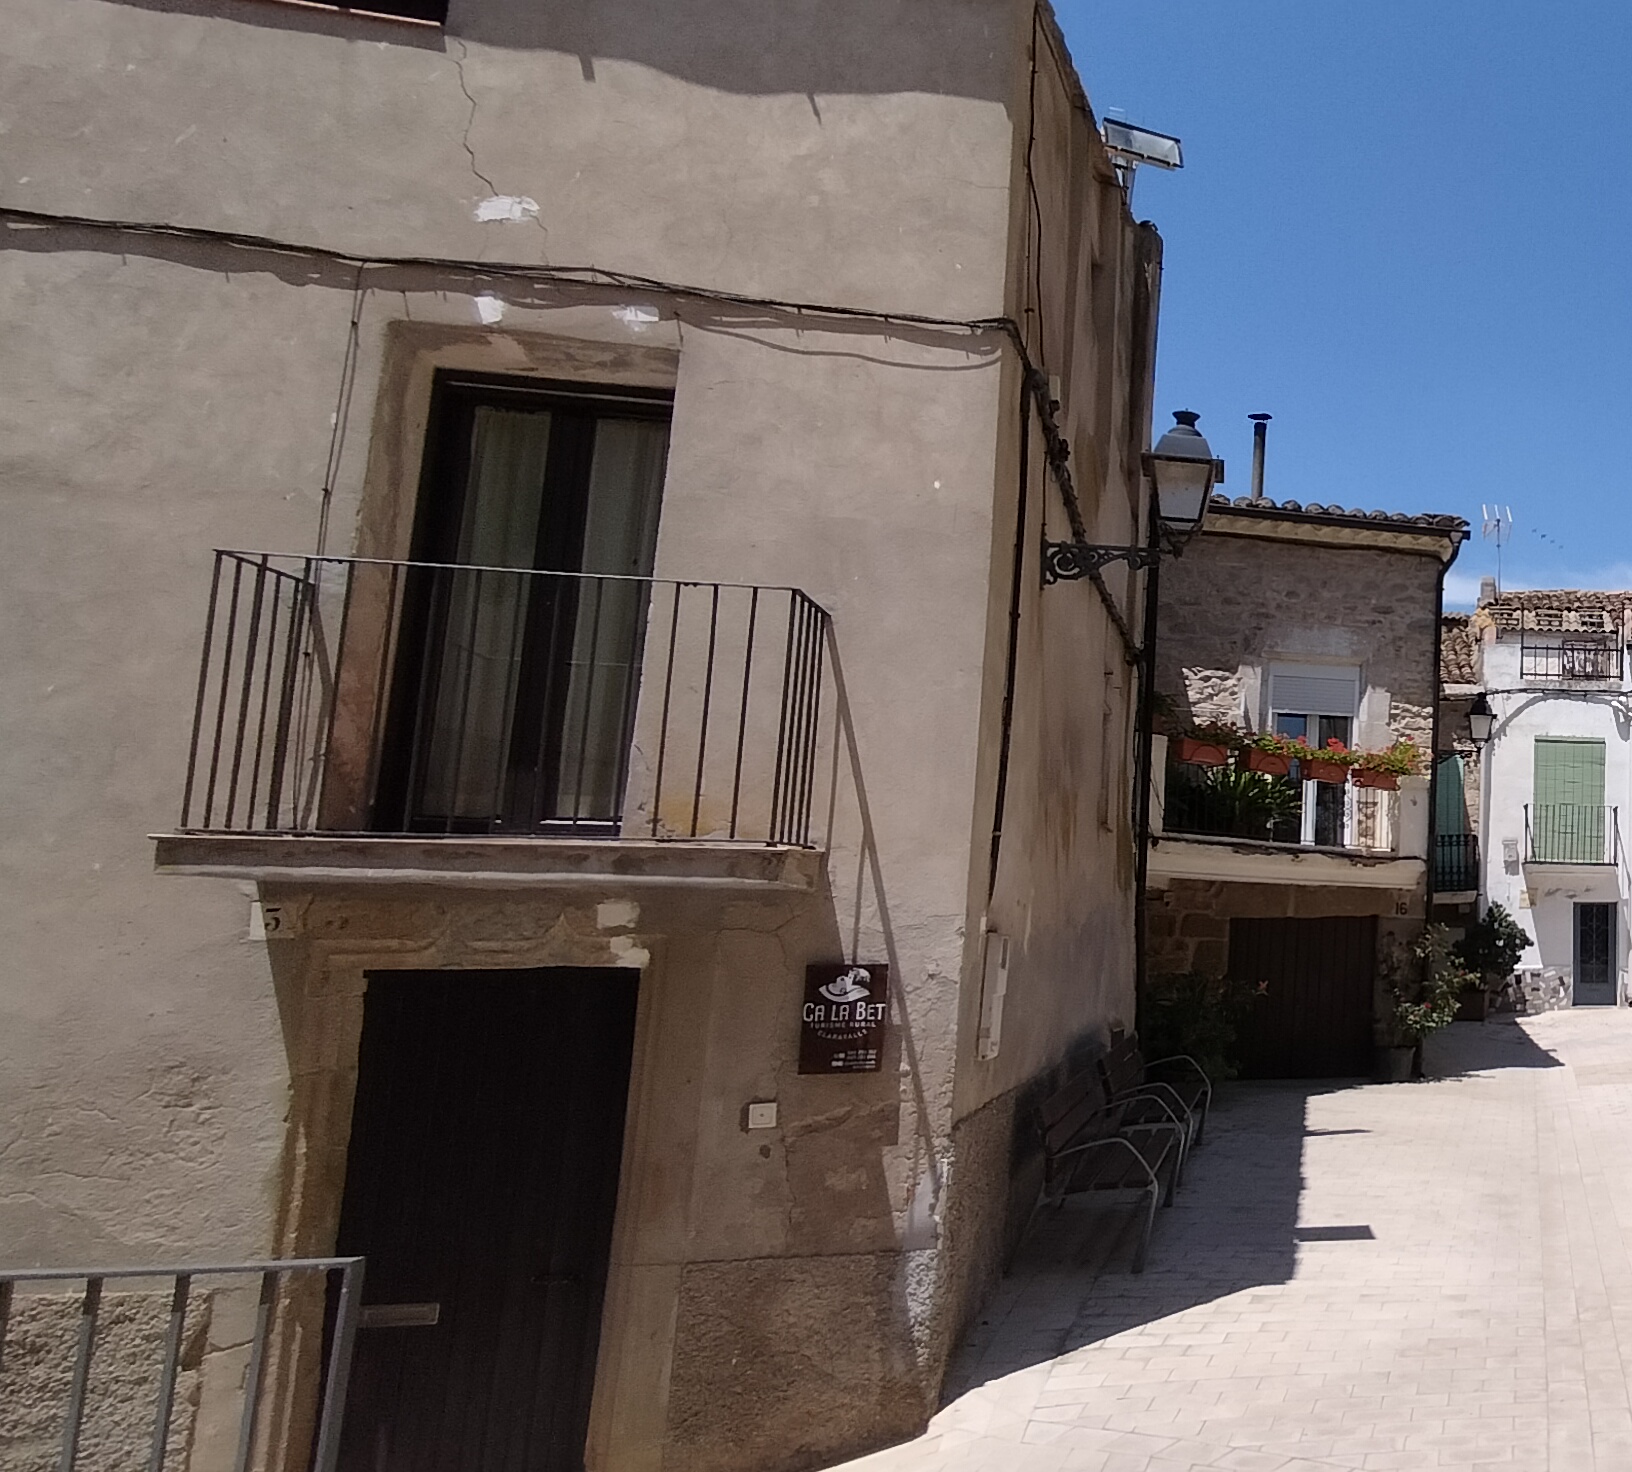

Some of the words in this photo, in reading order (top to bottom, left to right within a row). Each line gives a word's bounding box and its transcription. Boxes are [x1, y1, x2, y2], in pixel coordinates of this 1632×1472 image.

[1395, 902, 1408, 915] 16
[264, 907, 282, 931] 5
[831, 1004, 849, 1021] LA
[856, 1001, 886, 1020] BET
